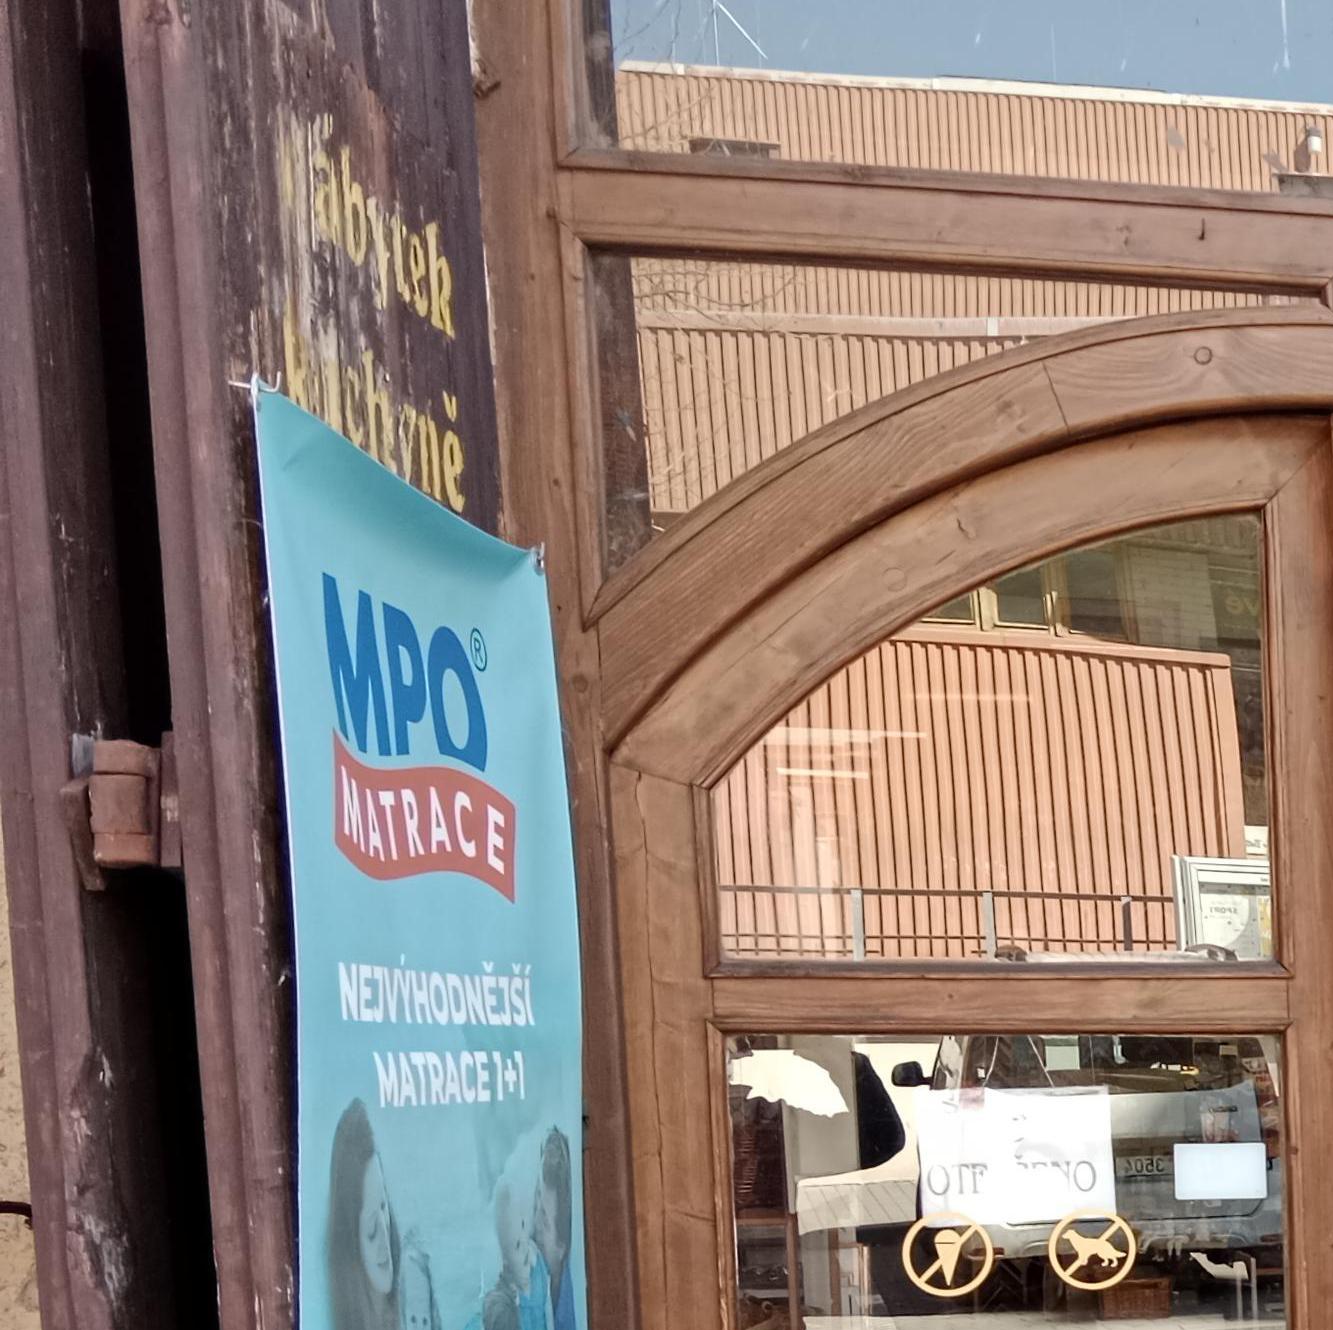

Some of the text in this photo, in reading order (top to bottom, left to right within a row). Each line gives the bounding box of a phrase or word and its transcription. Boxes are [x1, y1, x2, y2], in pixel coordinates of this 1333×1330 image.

[340, 765, 506, 876] MATRACE
[338, 953, 537, 1028] NEJVÝHODNĚJŠÍ
[373, 1049, 526, 1109] MATRACE 1+1
